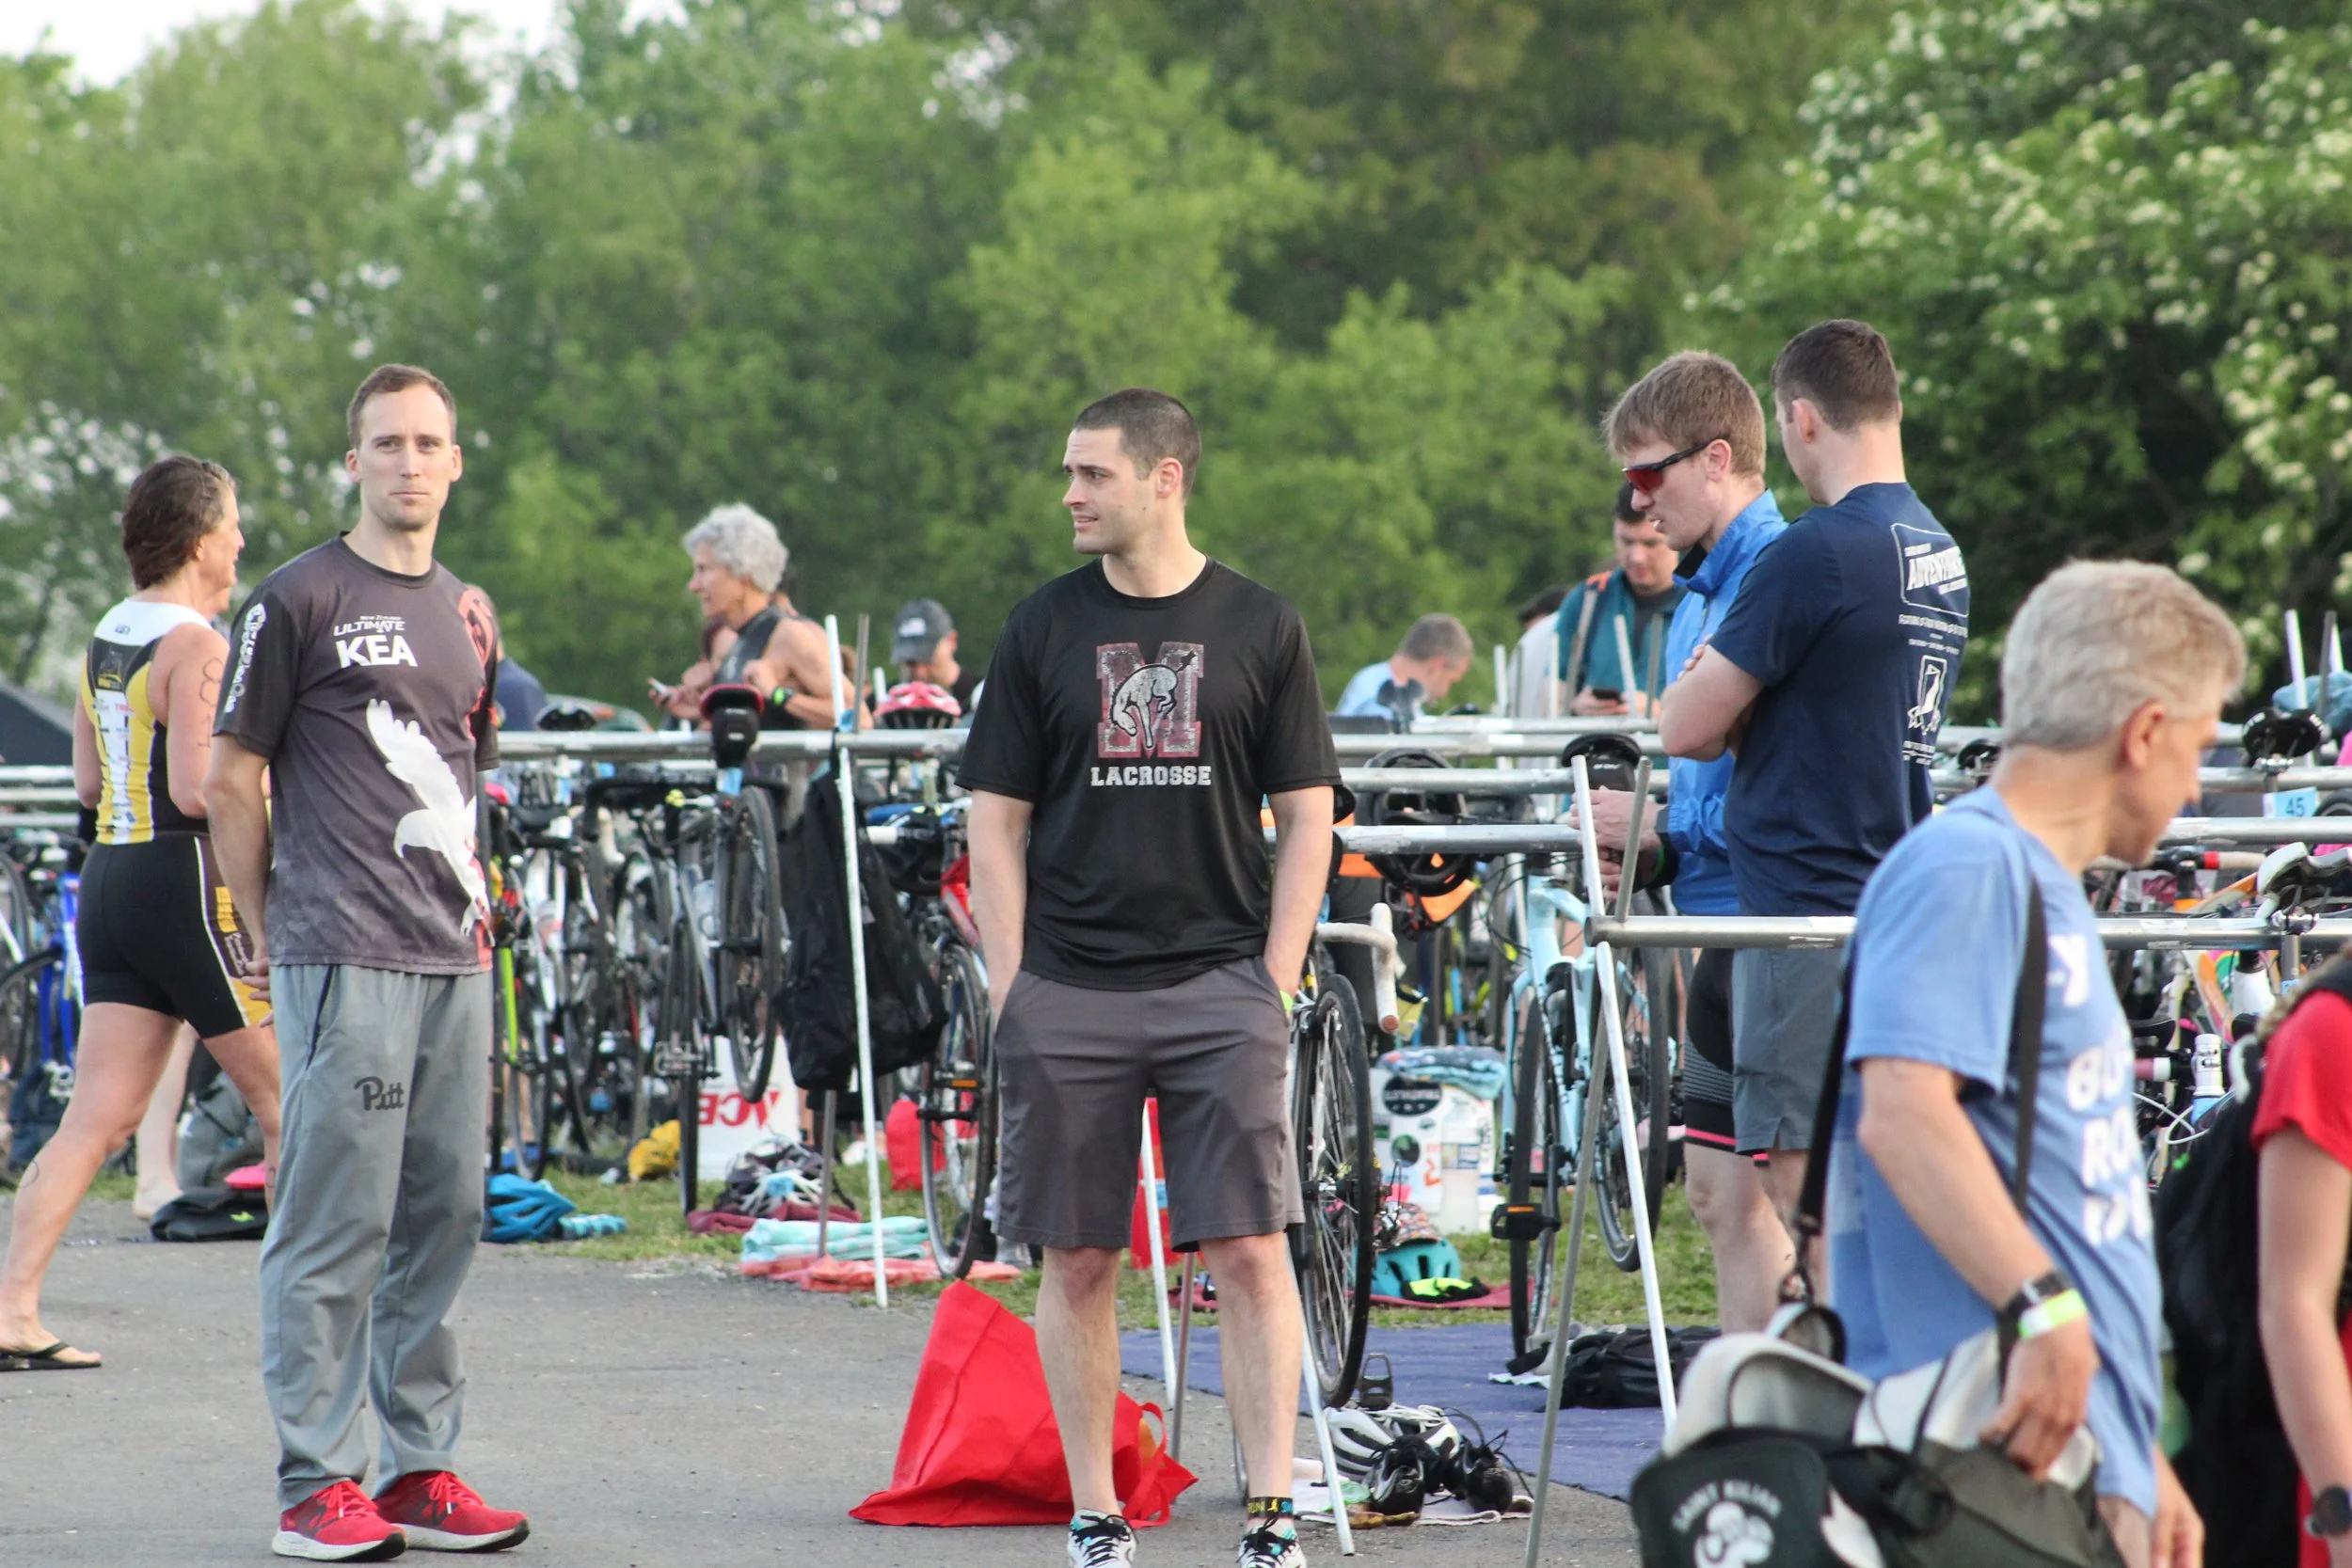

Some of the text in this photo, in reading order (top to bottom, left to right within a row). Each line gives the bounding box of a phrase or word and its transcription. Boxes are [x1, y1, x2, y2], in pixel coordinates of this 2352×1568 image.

[332, 621, 405, 636] ULTIMATE
[335, 634, 419, 669] KEA
[1096, 641, 1204, 758] M
[1090, 766, 1212, 786] LACROSSE
[2285, 798, 2305, 817] 45
[354, 1076, 405, 1111] Pitt
